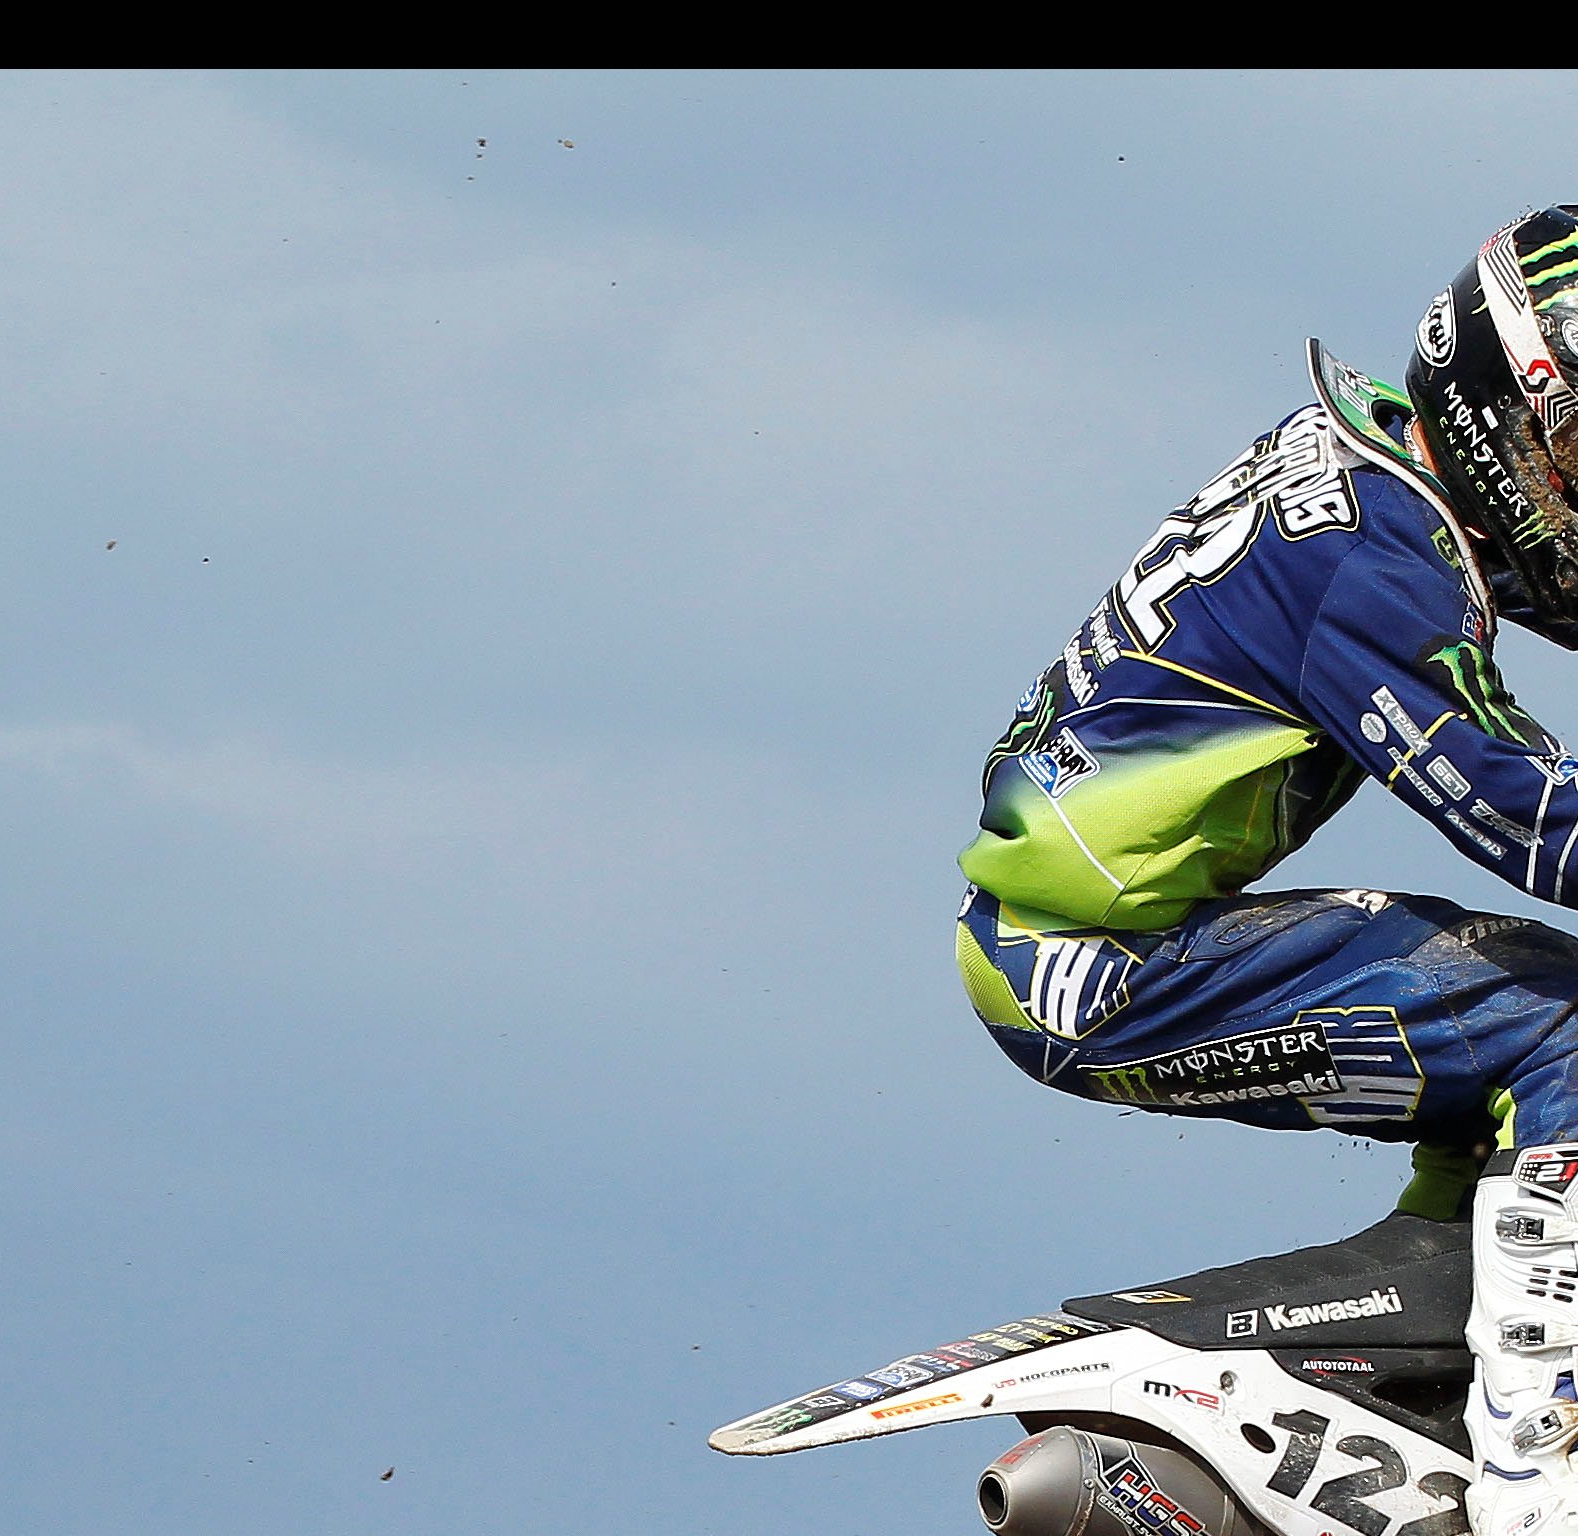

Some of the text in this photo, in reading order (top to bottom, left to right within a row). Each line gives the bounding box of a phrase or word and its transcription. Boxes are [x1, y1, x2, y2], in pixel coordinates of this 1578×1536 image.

[1439, 415, 1498, 506] ENERGY
[1444, 381, 1531, 517] MONSTER
[1388, 747, 1444, 807] BRAKING
[1431, 761, 1466, 797] GET
[1155, 1030, 1326, 1080] MONSTER
[1196, 1060, 1298, 1083] ENERGY
[1169, 1070, 1340, 1106] Kawasaki
[1264, 1286, 1405, 1331] Kawasaki
[1020, 1362, 1111, 1383] HOCOPARTS
[1302, 1359, 1375, 1372] AUTOTOTAAL
